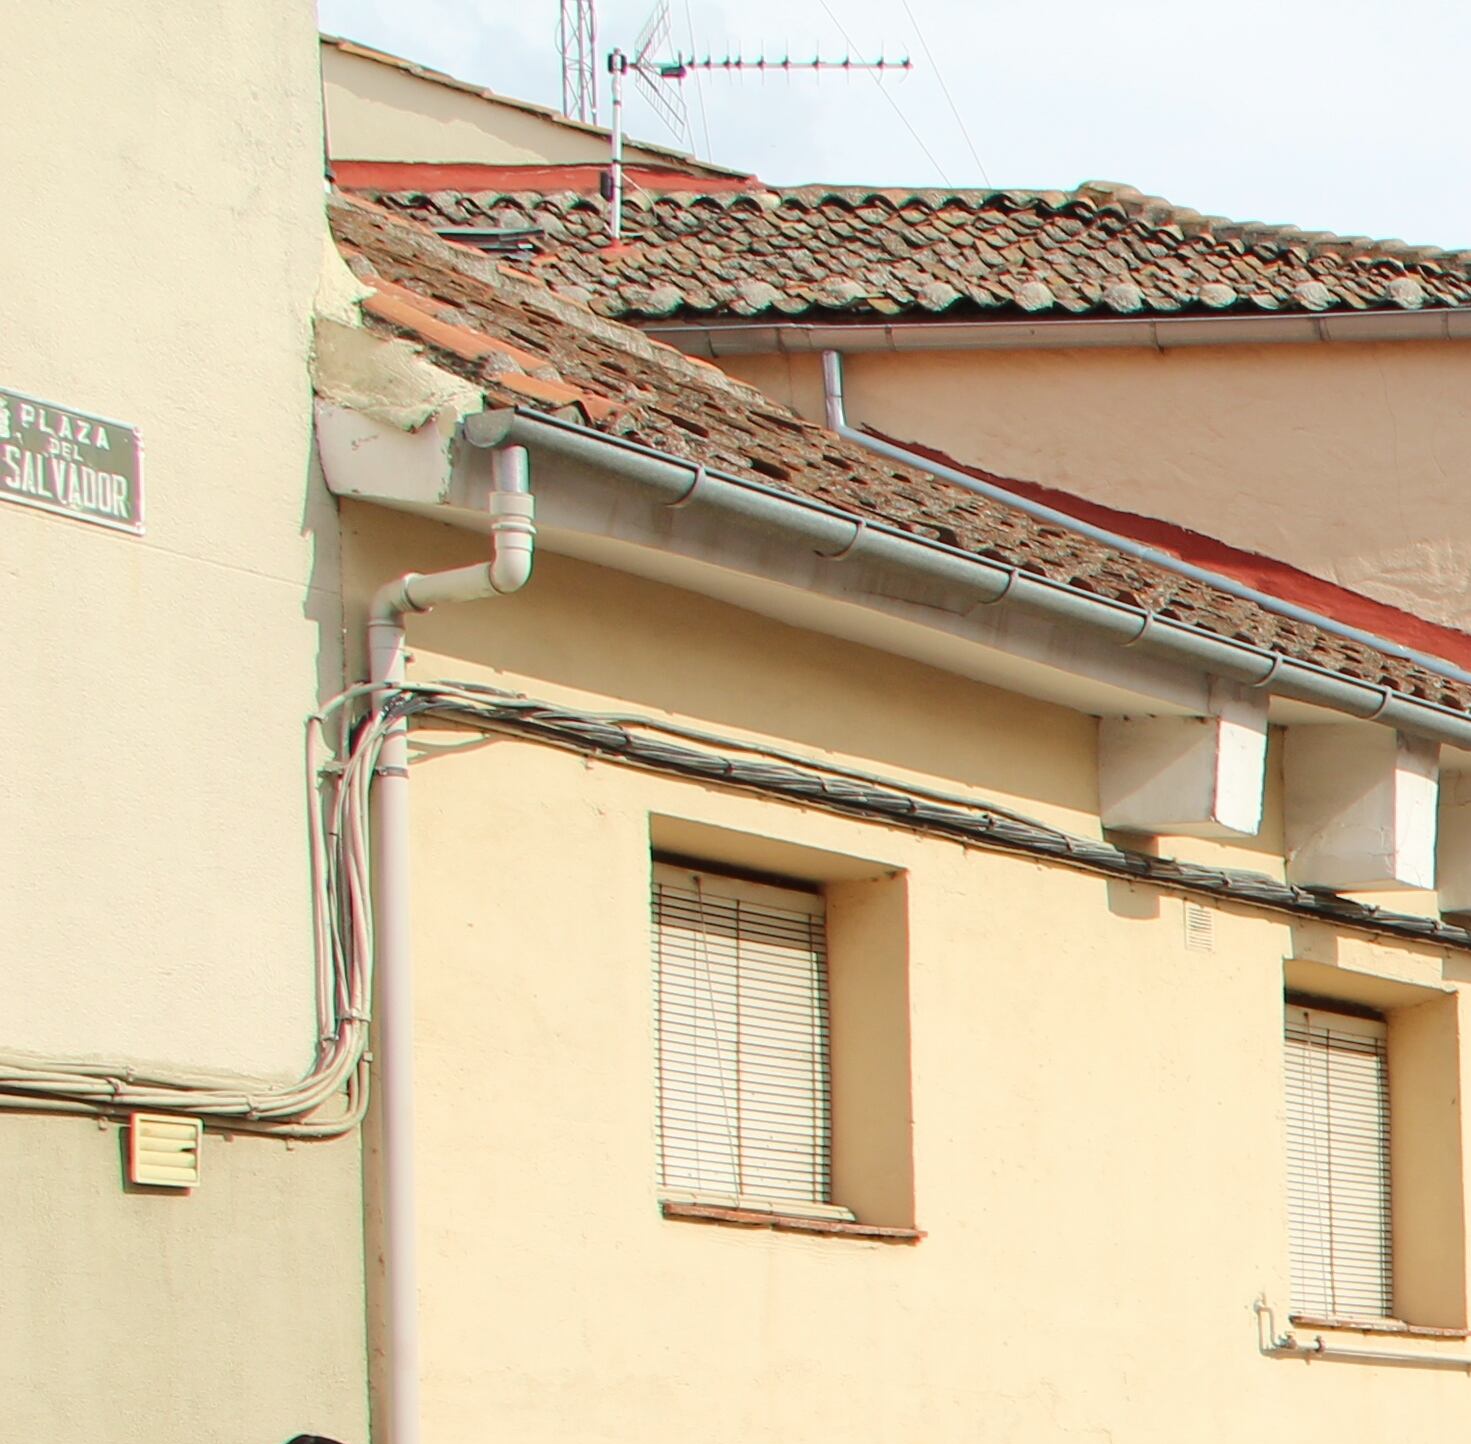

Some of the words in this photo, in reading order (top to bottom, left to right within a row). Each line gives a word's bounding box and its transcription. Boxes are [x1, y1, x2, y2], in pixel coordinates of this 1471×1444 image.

[20, 402, 110, 450] PLAZA
[45, 436, 84, 462] DEL
[4, 444, 129, 519] SALVADOR
